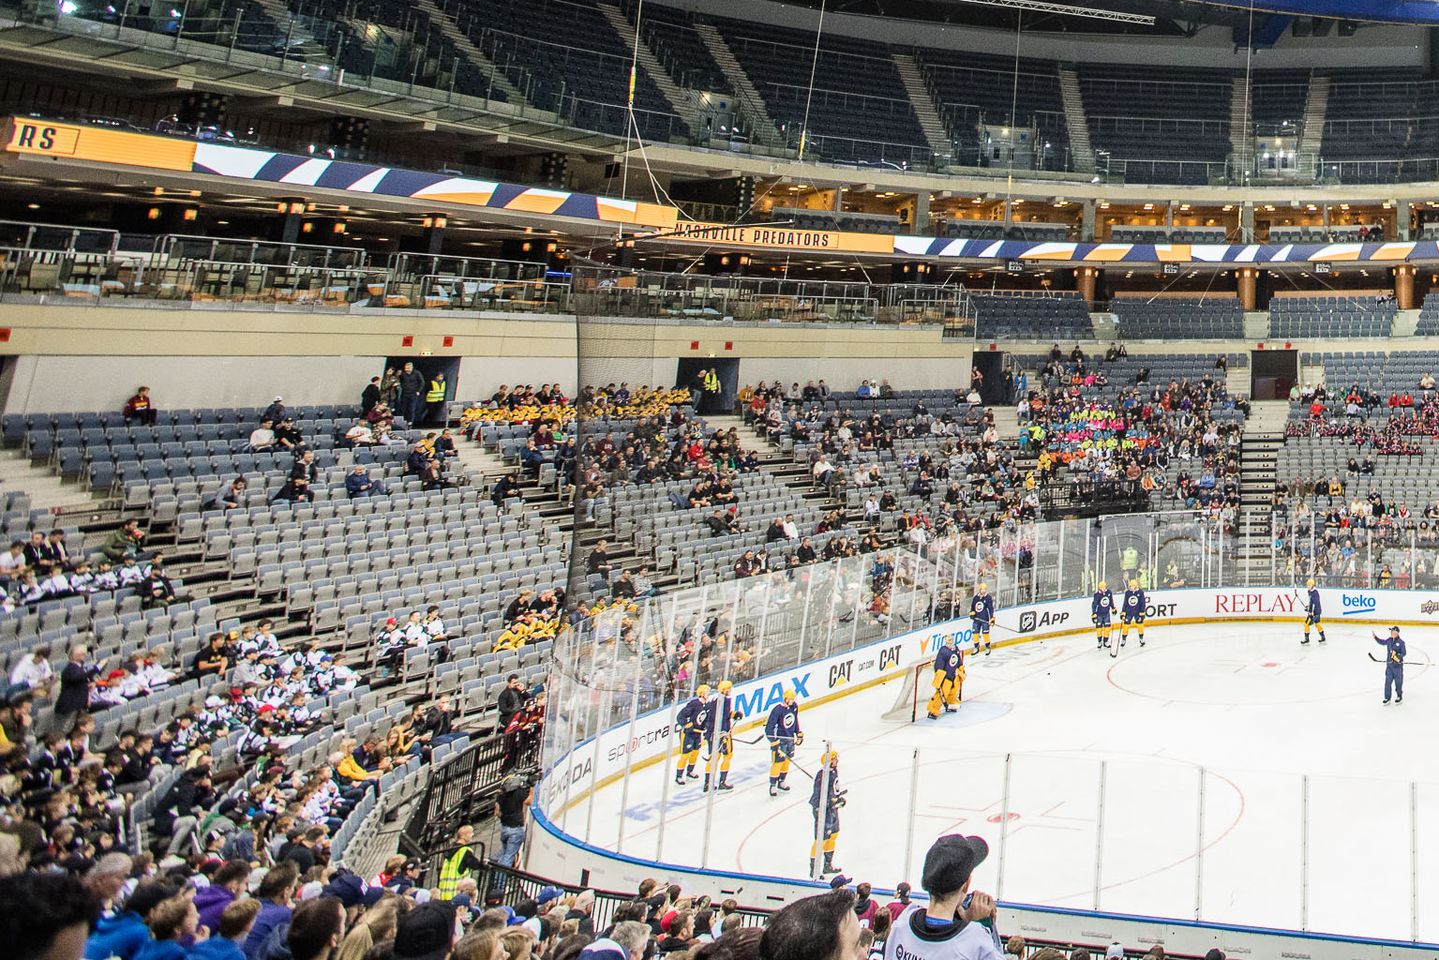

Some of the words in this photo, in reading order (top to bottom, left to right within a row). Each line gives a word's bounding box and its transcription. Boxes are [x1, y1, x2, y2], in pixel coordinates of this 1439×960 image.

[674, 222, 745, 242] NASHVILLE
[754, 230, 829, 247] PREDATORS
[1145, 603, 1178, 617] ORT
[1215, 593, 1298, 613] REPLAY
[1342, 593, 1376, 609] beko
[879, 644, 902, 672] CAT
[828, 659, 854, 689] CAT
